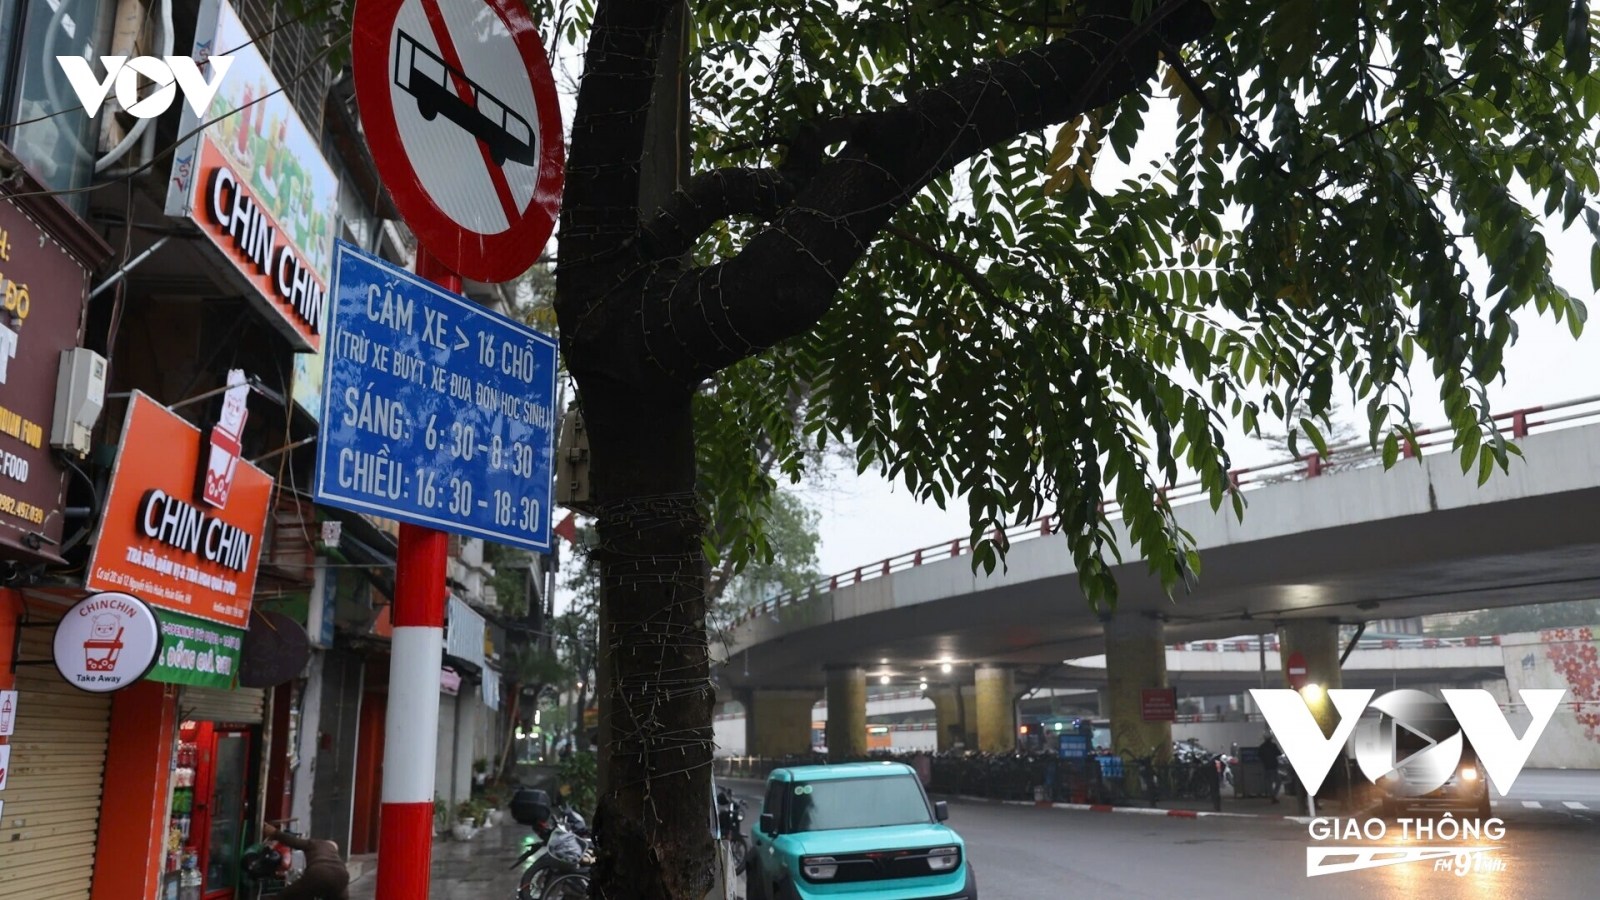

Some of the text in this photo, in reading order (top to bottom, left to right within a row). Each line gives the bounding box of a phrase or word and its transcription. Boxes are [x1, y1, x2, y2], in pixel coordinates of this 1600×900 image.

[213, 166, 326, 336] CHIN CHIN
[366, 280, 413, 336] CẤM
[422, 306, 449, 351] XE
[477, 330, 496, 369] 16
[501, 338, 535, 384] CHỖ
[335, 326, 369, 364] (TRỪ
[372, 344, 389, 370] XE
[431, 367, 446, 393] XE
[450, 373, 473, 400] ĐƯA
[476, 377, 498, 410] ĐÓN
[20, 419, 42, 449] FOOD
[344, 382, 410, 440] SÁNG:
[3, 451, 29, 483] FOOD
[338, 444, 410, 501] CHIỀU:
[143, 489, 253, 572] CHIN CHIN
[78, 598, 137, 619] CHINCHIN
[76, 673, 121, 685] Take Away
